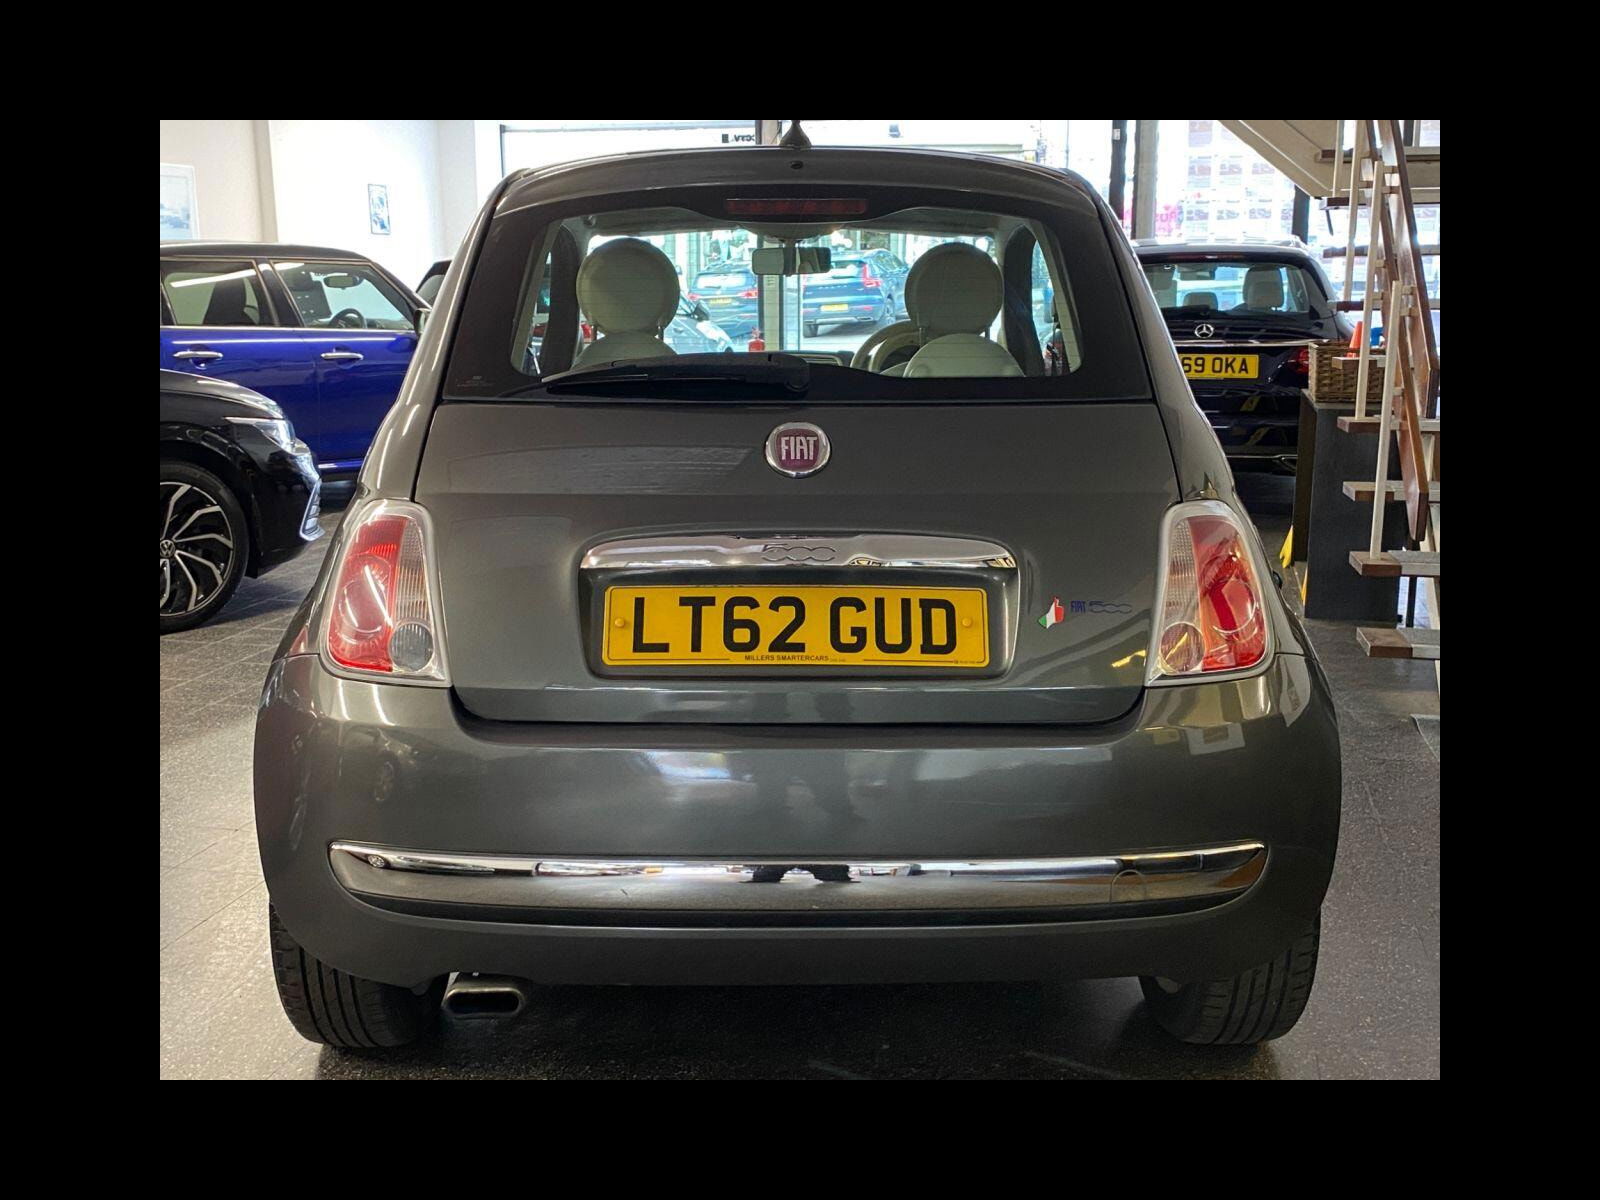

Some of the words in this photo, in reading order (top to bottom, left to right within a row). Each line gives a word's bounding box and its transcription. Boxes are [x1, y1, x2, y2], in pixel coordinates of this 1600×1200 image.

[1182, 357, 1205, 373] 69
[1212, 357, 1249, 374] OKA
[780, 436, 818, 461] FIAT
[761, 543, 836, 562] 500
[1070, 600, 1086, 613] FIAT
[1088, 600, 1133, 614] 500
[632, 596, 807, 653] LT62
[830, 597, 957, 654] GUD
